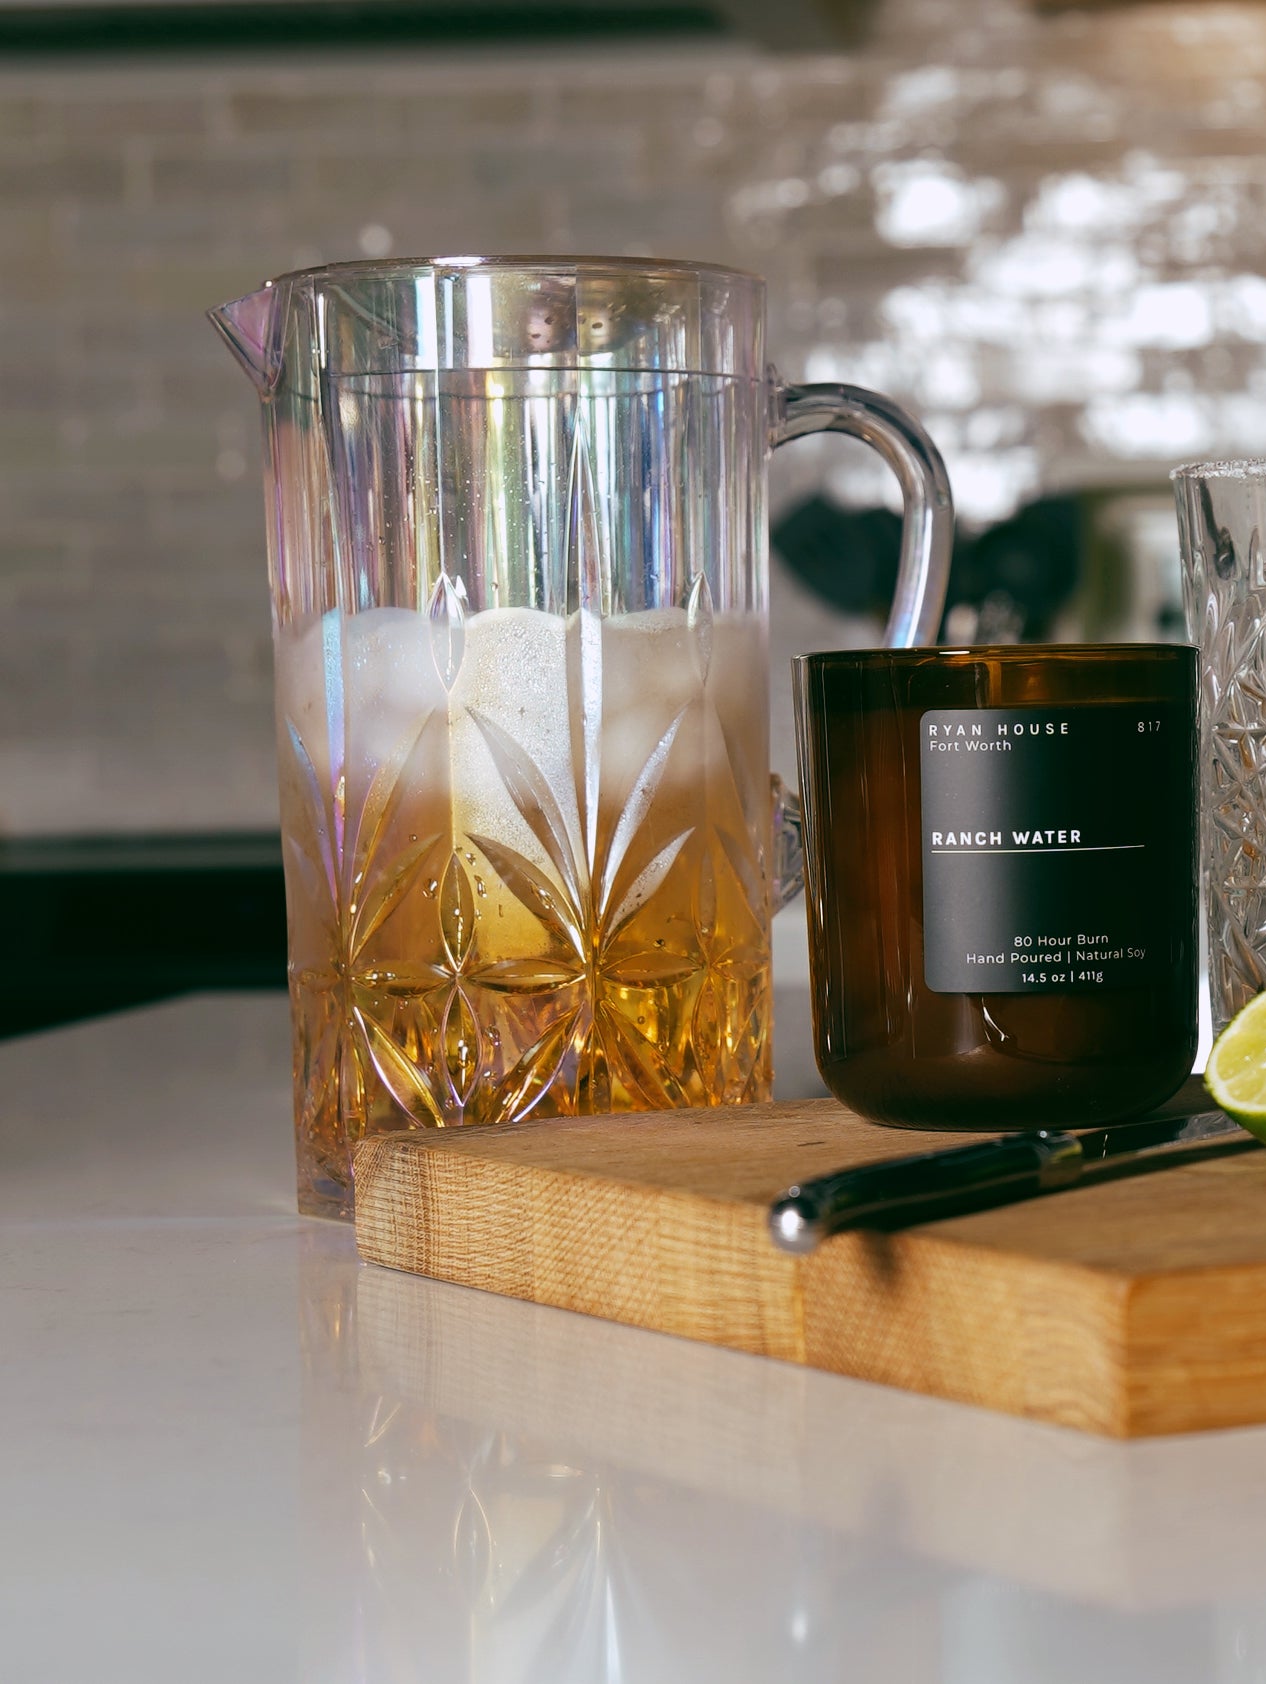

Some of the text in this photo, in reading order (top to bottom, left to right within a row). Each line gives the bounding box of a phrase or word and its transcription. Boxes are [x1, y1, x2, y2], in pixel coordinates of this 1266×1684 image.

[928, 722, 1070, 737] RYAN HOUSE
[1137, 720, 1162, 733] 817
[929, 739, 1012, 752] Fort Worth
[932, 829, 1082, 846] RANCH WATER
[1013, 933, 1109, 948] 80 Hour Burn
[966, 952, 1005, 965] Hand
[1010, 951, 1062, 964] Poured
[1076, 948, 1124, 962] Natural
[1127, 947, 1147, 960] Soy
[1022, 972, 1047, 984] 14.5
[1051, 972, 1066, 983] oz
[1078, 970, 1104, 983] 411g
